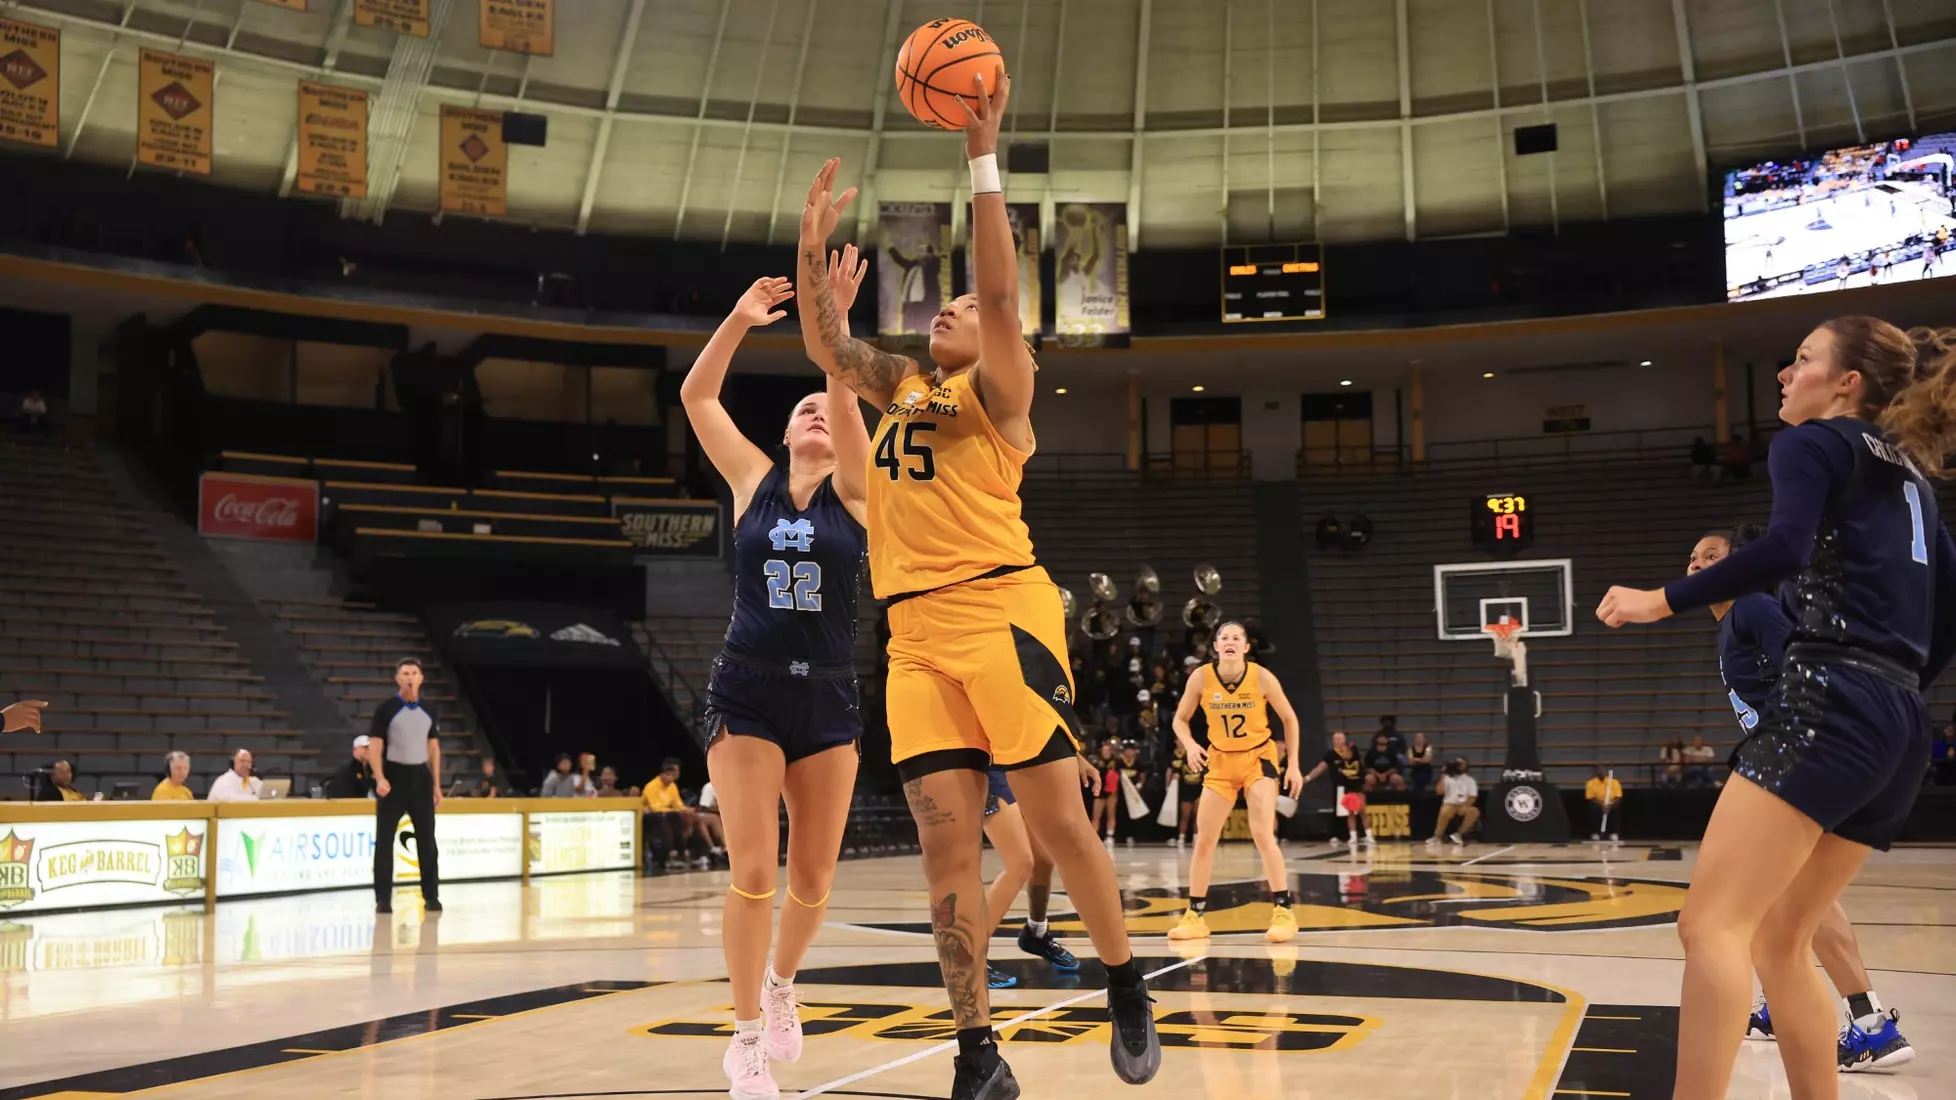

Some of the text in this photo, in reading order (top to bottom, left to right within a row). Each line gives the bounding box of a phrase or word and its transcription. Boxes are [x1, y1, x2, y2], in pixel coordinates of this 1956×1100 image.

[925, 400, 959, 417] MISS
[874, 421, 938, 481] 45
[214, 492, 299, 527] Coca-Cola
[621, 512, 717, 533] SOUTHERN
[1903, 480, 1929, 566] 1
[644, 531, 684, 548] MISS
[763, 558, 823, 612] 22
[1220, 713, 1248, 739] 12
[47, 853, 77, 879] KEG
[96, 849, 151, 874] BARREL
